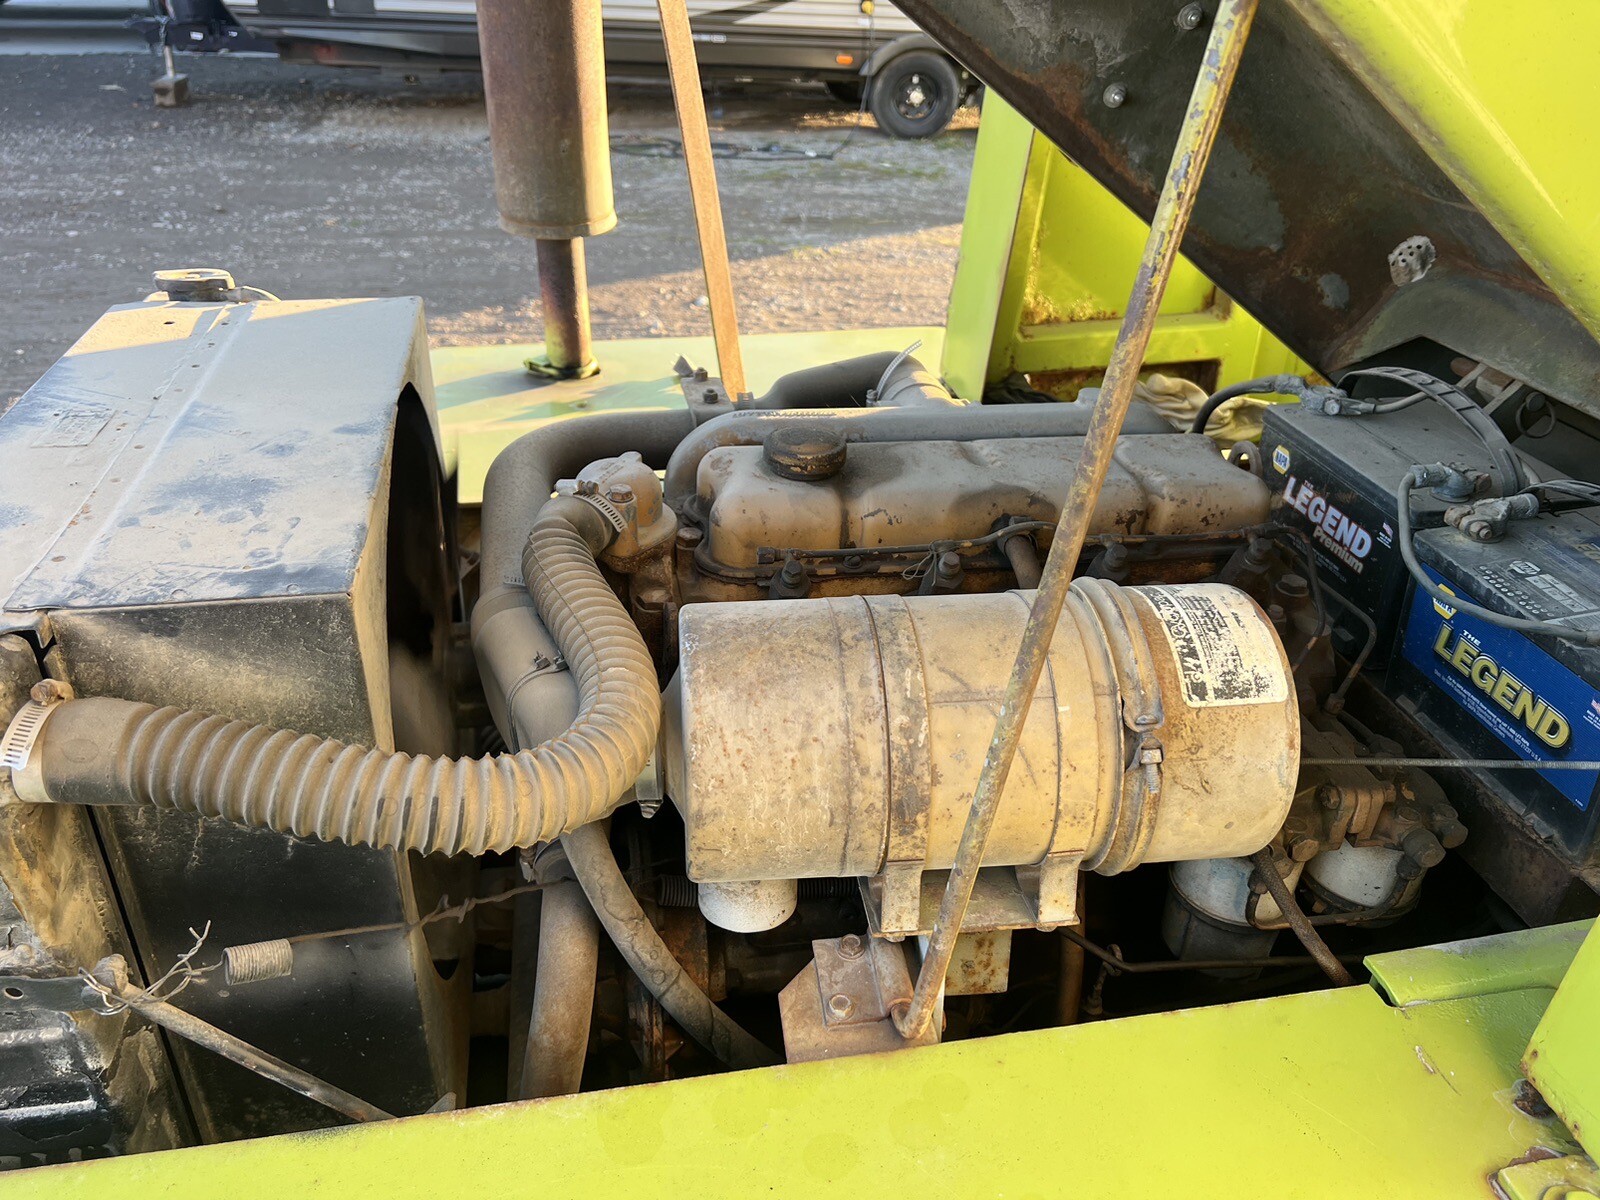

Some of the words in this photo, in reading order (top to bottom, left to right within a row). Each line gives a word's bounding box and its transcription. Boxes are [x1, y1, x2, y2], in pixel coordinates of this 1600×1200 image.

[1282, 475, 1372, 558] LEGEND
[1312, 525, 1364, 574] Premium
[1462, 629, 1481, 646] THE
[1432, 620, 1570, 748] LEGEND
